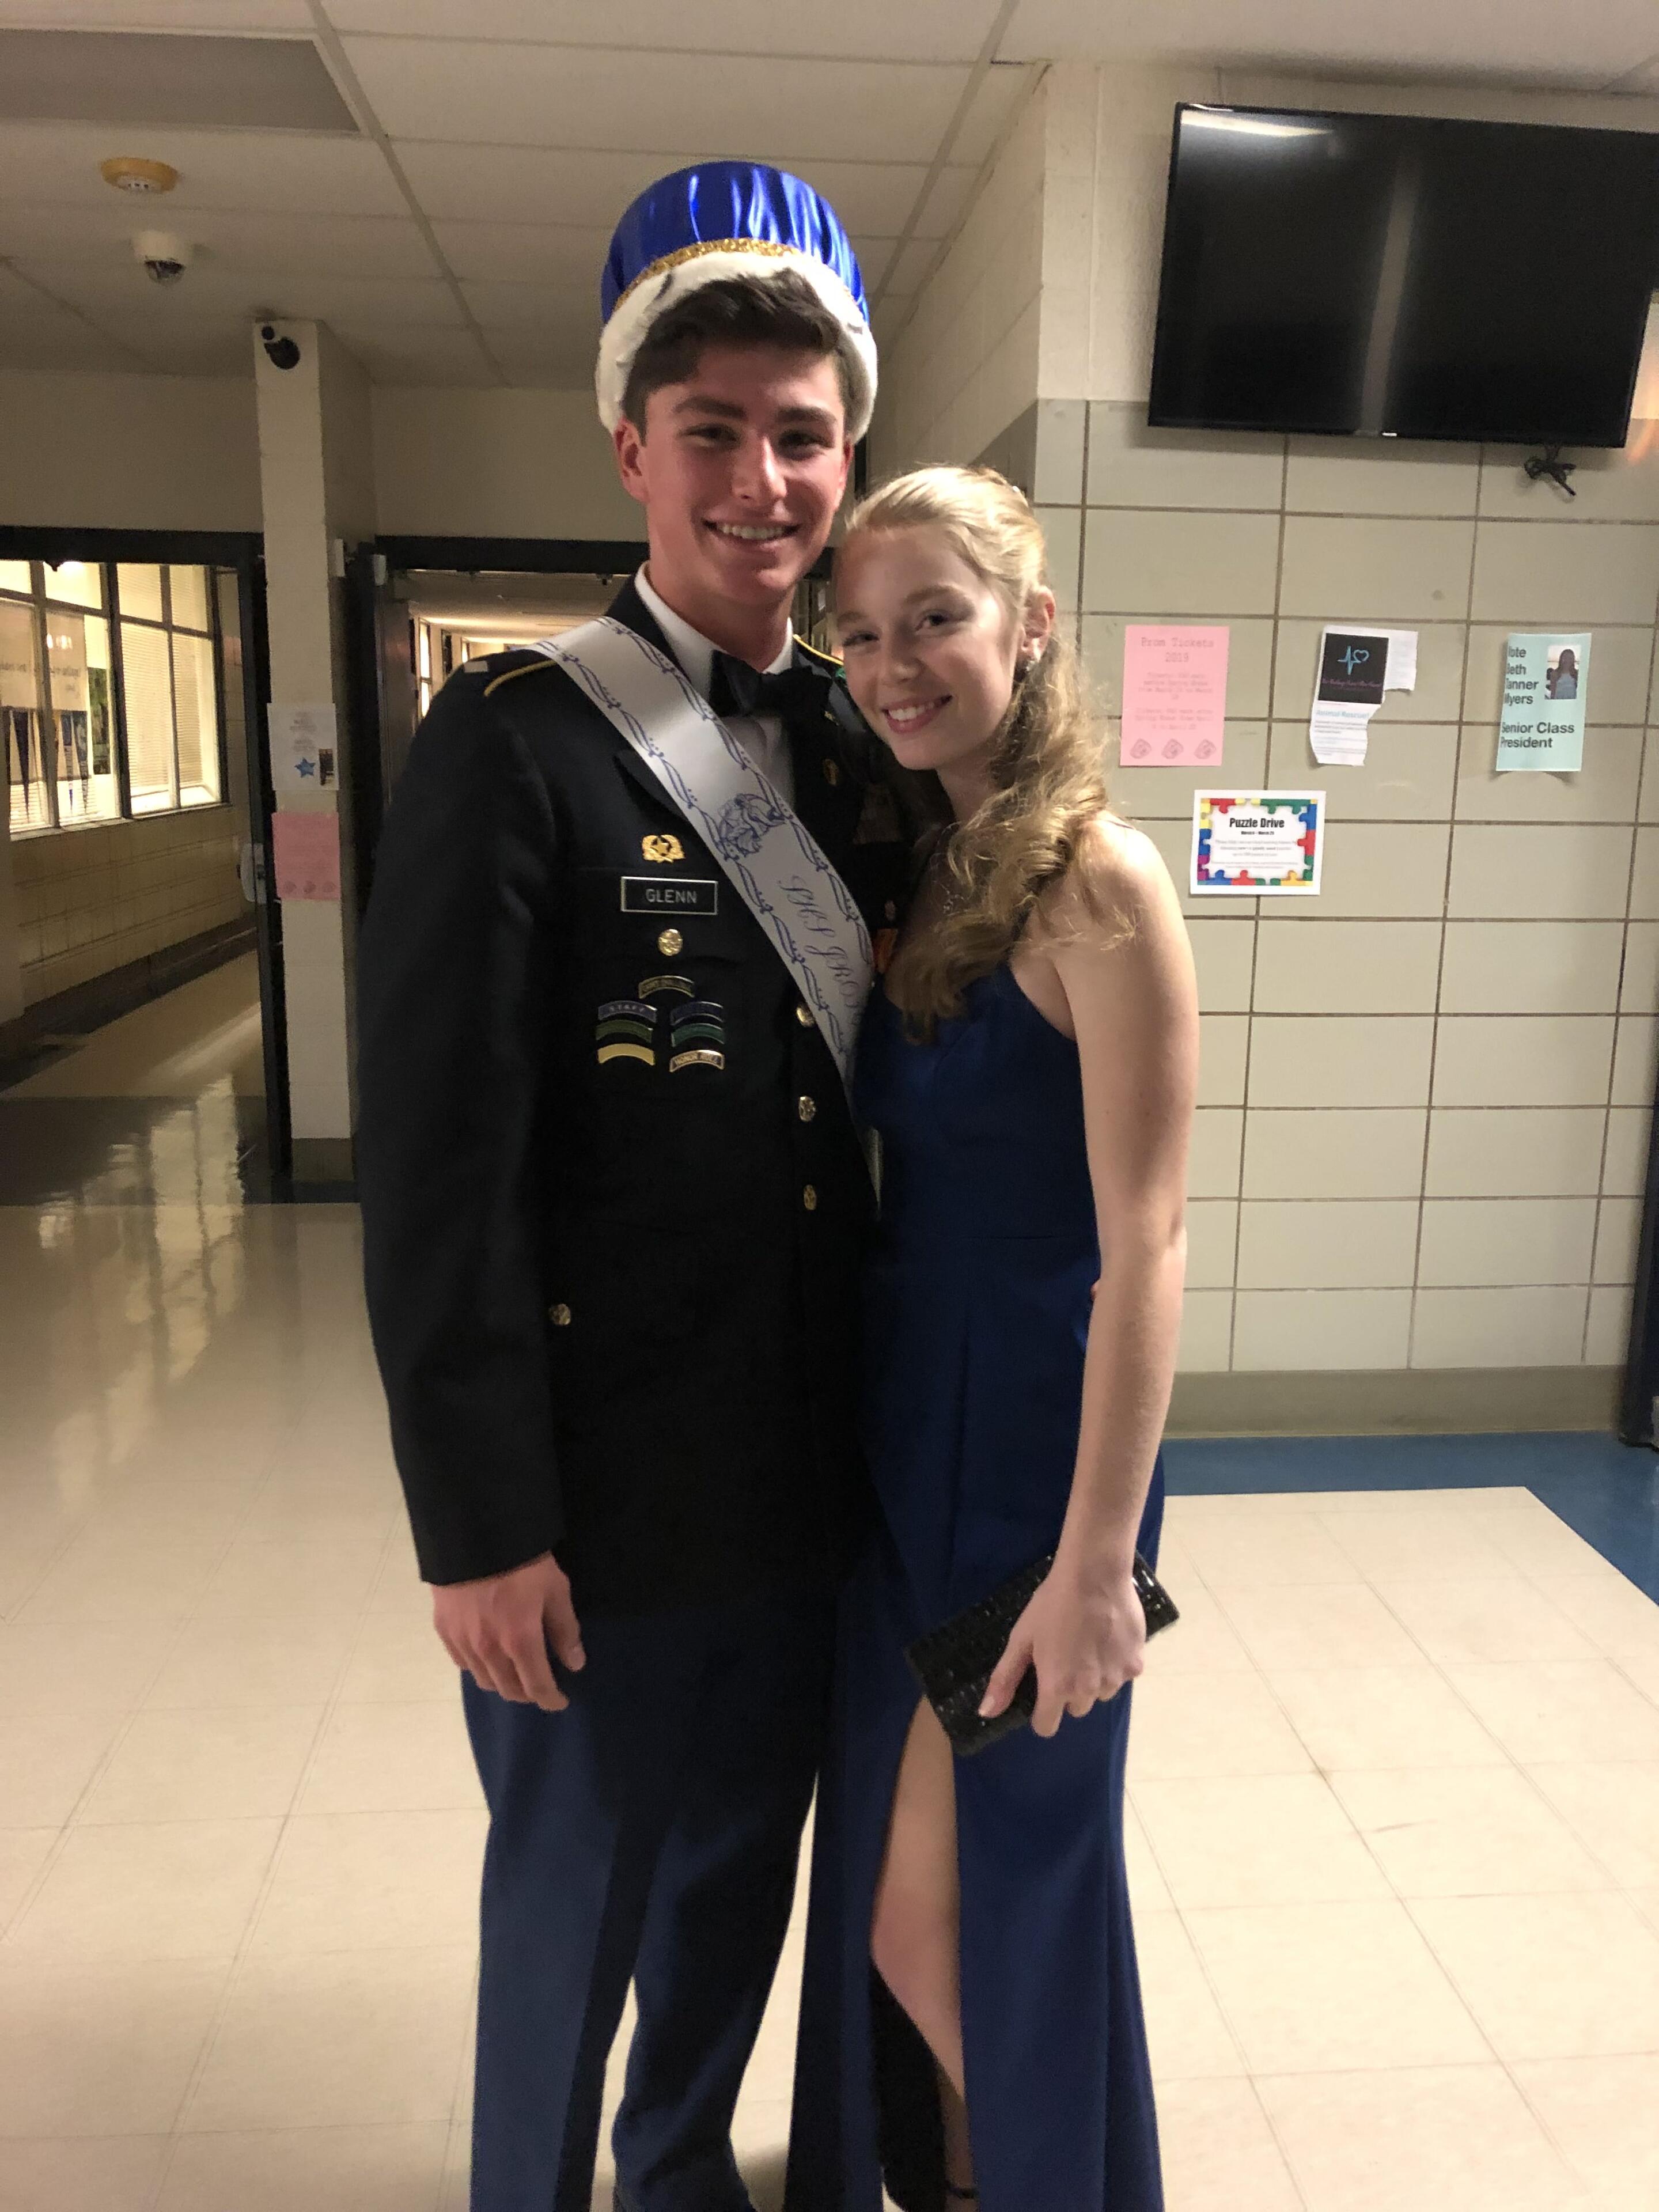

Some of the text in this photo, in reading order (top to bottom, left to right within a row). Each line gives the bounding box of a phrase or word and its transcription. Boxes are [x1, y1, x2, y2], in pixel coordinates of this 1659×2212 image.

[1141, 637, 1214, 647] Prom Tickets
[1509, 646, 1527, 657] ote
[1502, 722, 1574, 734] Senior Class
[1501, 736, 1553, 748] President
[1229, 818, 1285, 828] Puzzle Drive
[646, 888, 697, 903] GLENN
